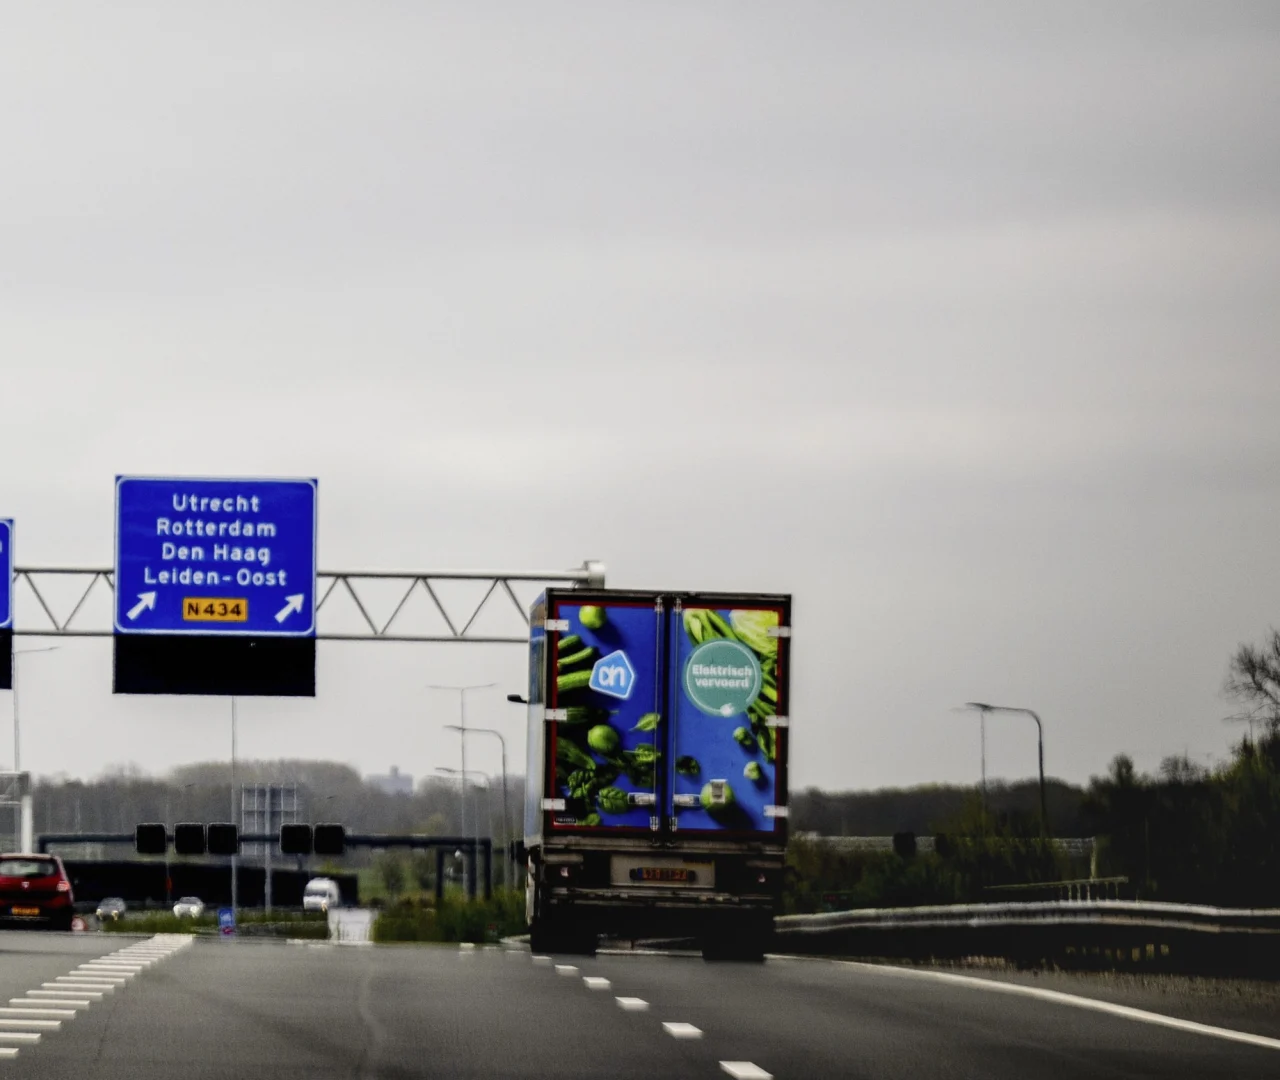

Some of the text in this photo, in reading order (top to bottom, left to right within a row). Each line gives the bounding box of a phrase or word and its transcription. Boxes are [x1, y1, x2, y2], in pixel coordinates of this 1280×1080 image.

[172, 493, 260, 512] Utrecht
[156, 518, 276, 537] Rotterdam
[162, 542, 271, 566] Den Haag
[692, 663, 752, 677] Elektrisch
[695, 676, 750, 689] vervoerd
